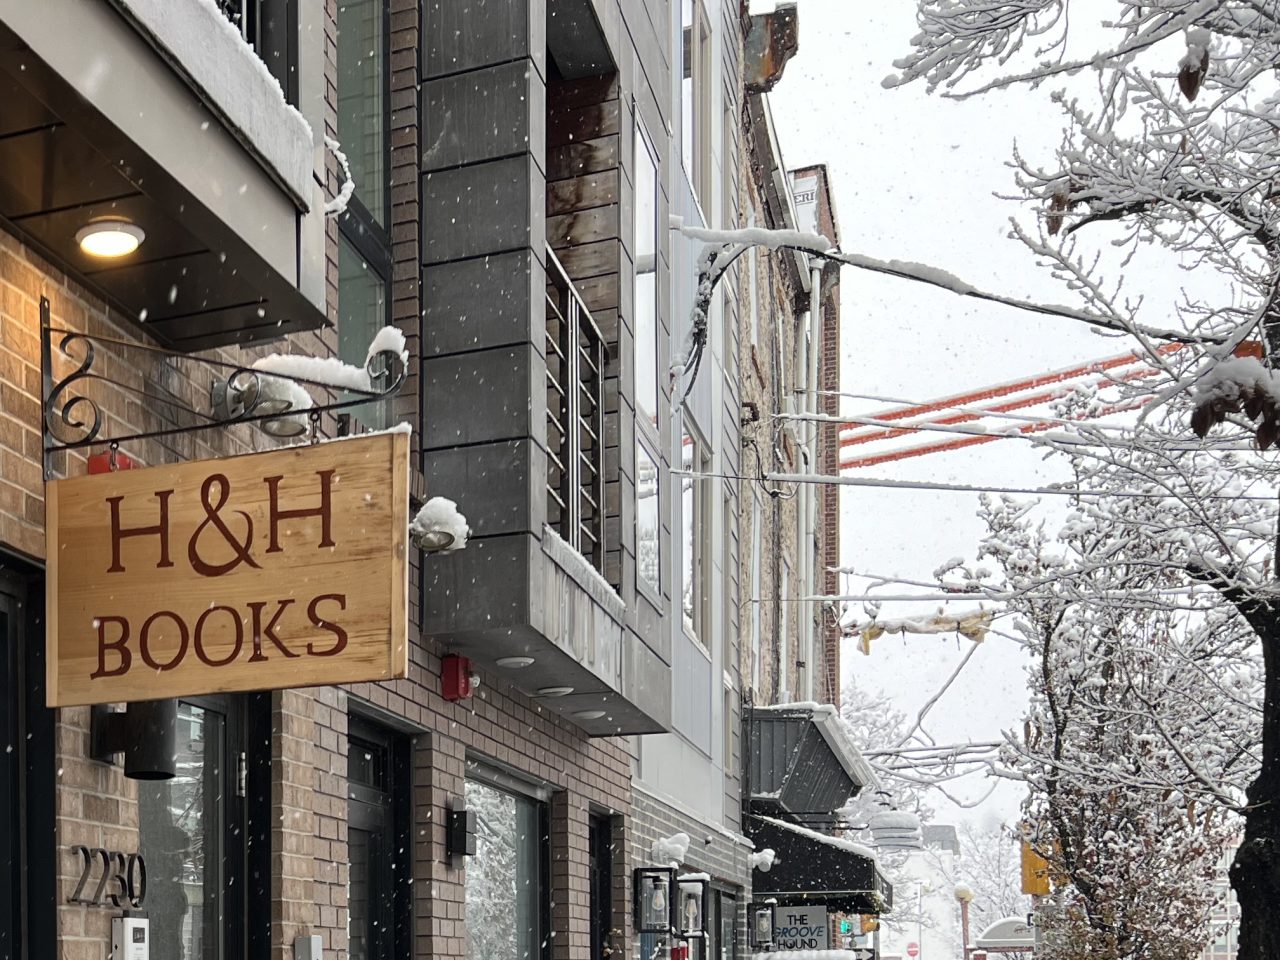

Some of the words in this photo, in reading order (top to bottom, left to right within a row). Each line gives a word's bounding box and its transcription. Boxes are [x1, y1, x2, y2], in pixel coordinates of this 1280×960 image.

[105, 468, 337, 578] H&H
[90, 593, 349, 681] BOOKS
[67, 845, 147, 909] 2230
[775, 926, 824, 938] GROOVE
[787, 914, 809, 926] THE
[778, 938, 818, 949] HOUND
